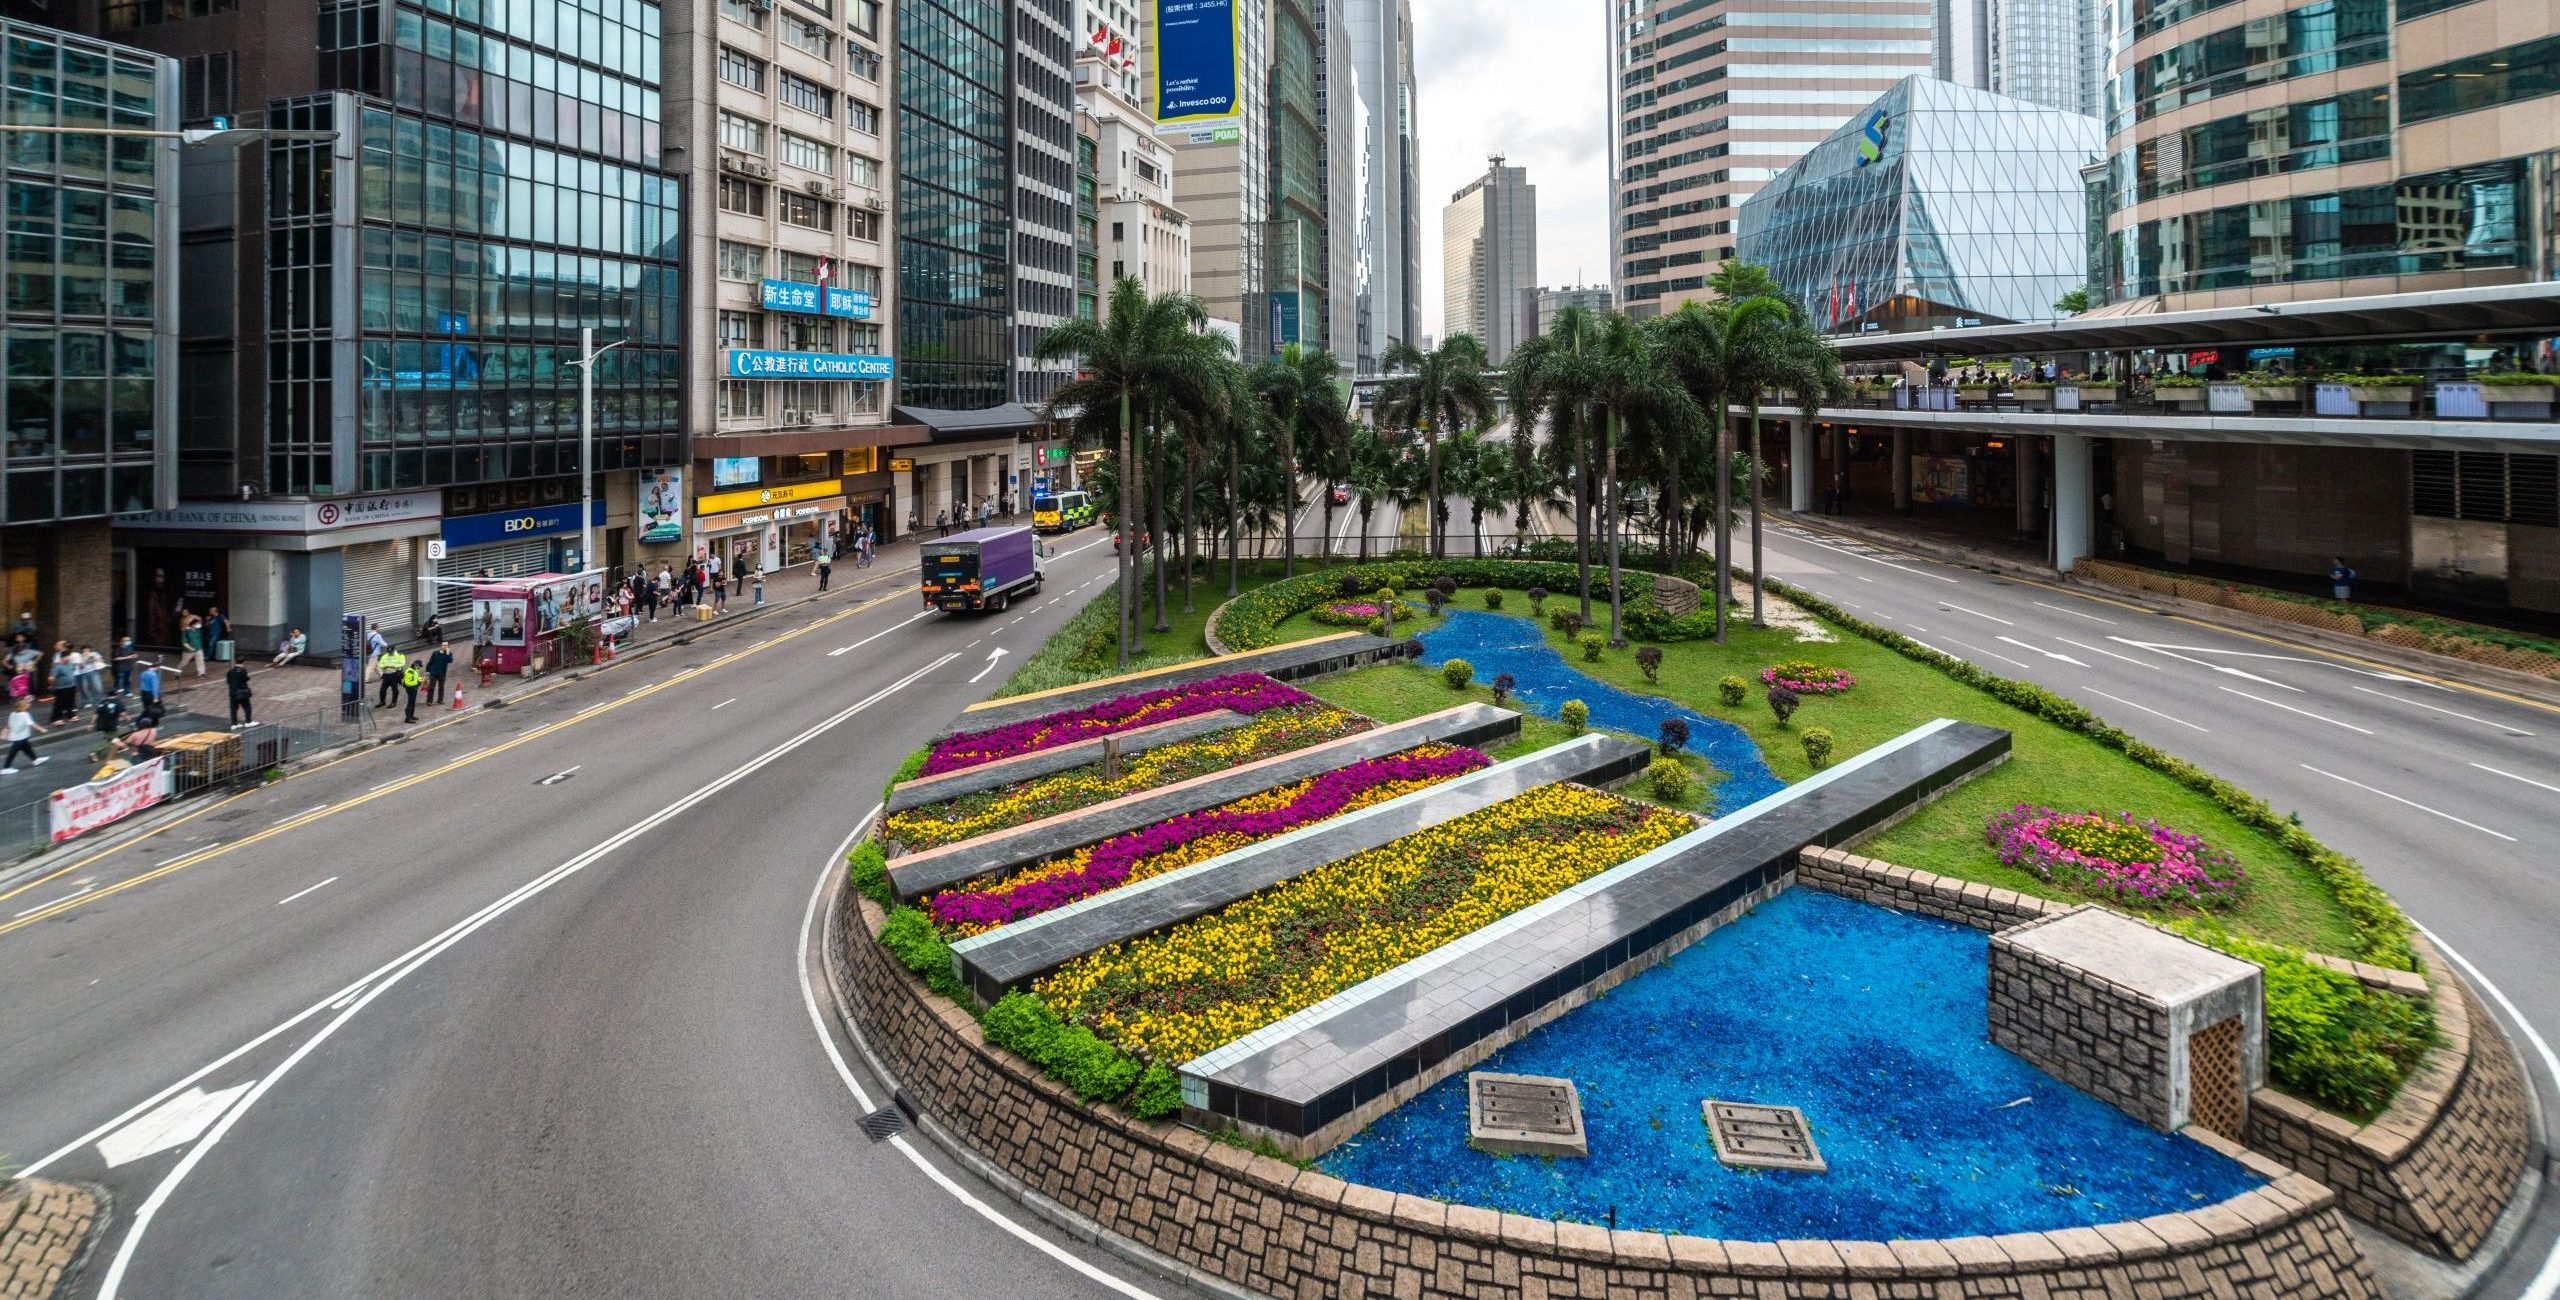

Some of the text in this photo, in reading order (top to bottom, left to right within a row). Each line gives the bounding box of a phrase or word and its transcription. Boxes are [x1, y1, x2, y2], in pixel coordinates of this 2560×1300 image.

[1180, 77, 1198, 85] rethink
[1166, 85, 1197, 94] possibility.
[1179, 99, 1209, 108] Invesco
[1215, 129, 1238, 140] POAD
[764, 285, 815, 308] 新生命堂
[752, 356, 809, 373] 公教進行社
[177, 511, 206, 523] BANK
[208, 512, 221, 523] OF
[223, 512, 257, 523] CHINA
[504, 517, 535, 533] BDO
